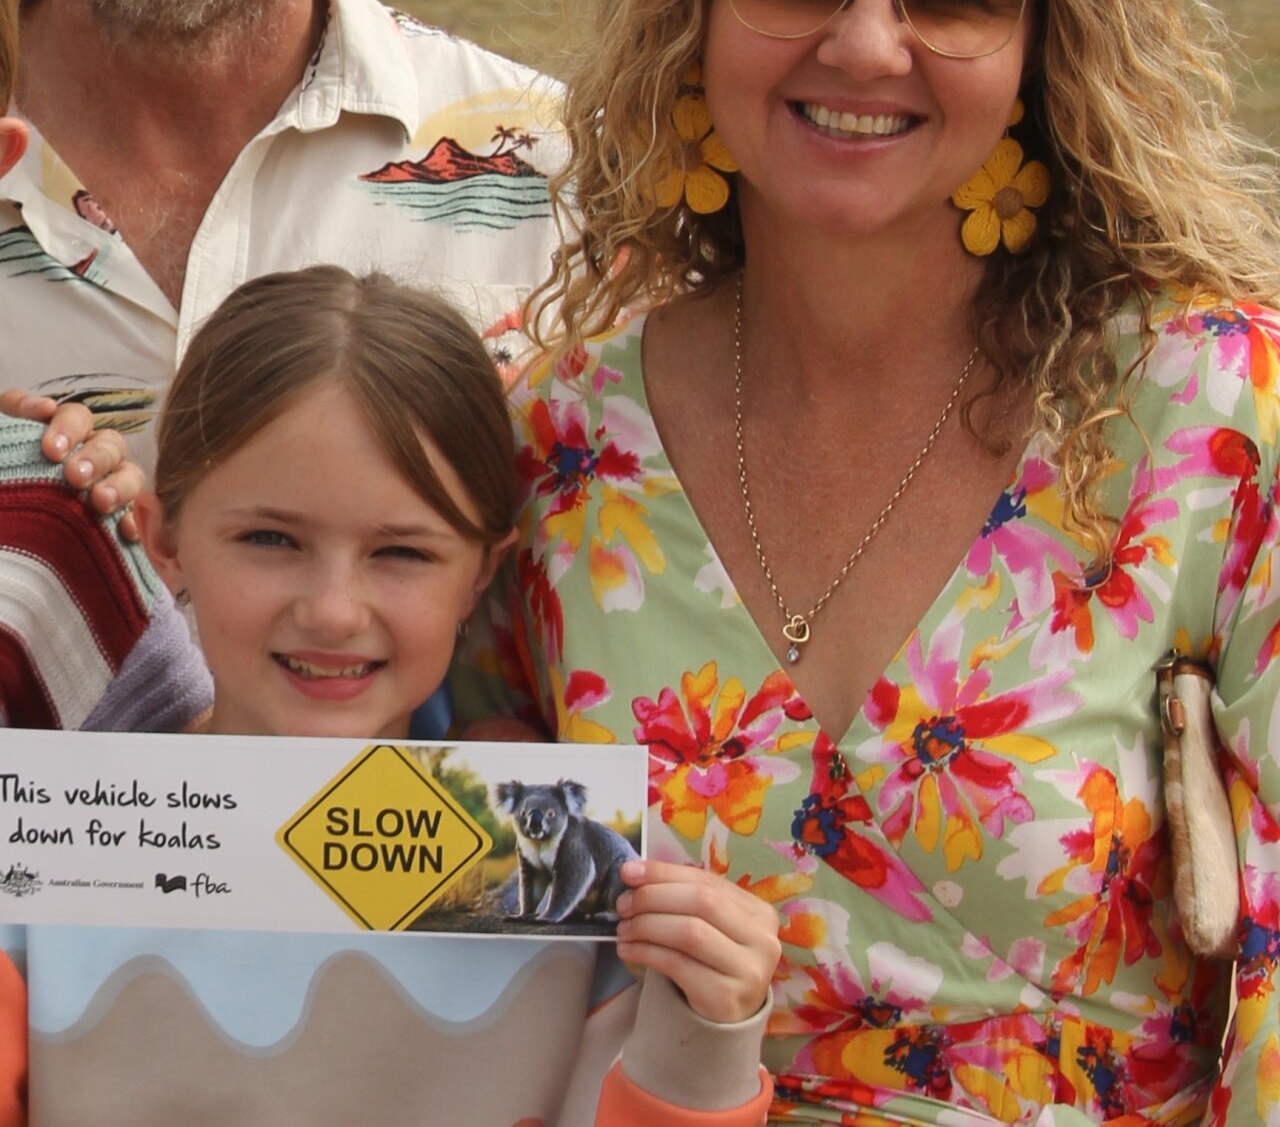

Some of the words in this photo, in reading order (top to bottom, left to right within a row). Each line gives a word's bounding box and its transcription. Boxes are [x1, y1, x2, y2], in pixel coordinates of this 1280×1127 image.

[64, 779, 156, 807] vehicle
[166, 780, 238, 810] slows
[8, 817, 74, 845] down
[85, 818, 127, 846] for
[138, 818, 221, 849] koalas
[325, 806, 443, 839] SLOW
[323, 842, 443, 874] DOWN
[48, 878, 91, 888] Australian
[92, 879, 144, 890] Government
[190, 873, 233, 898] fba
